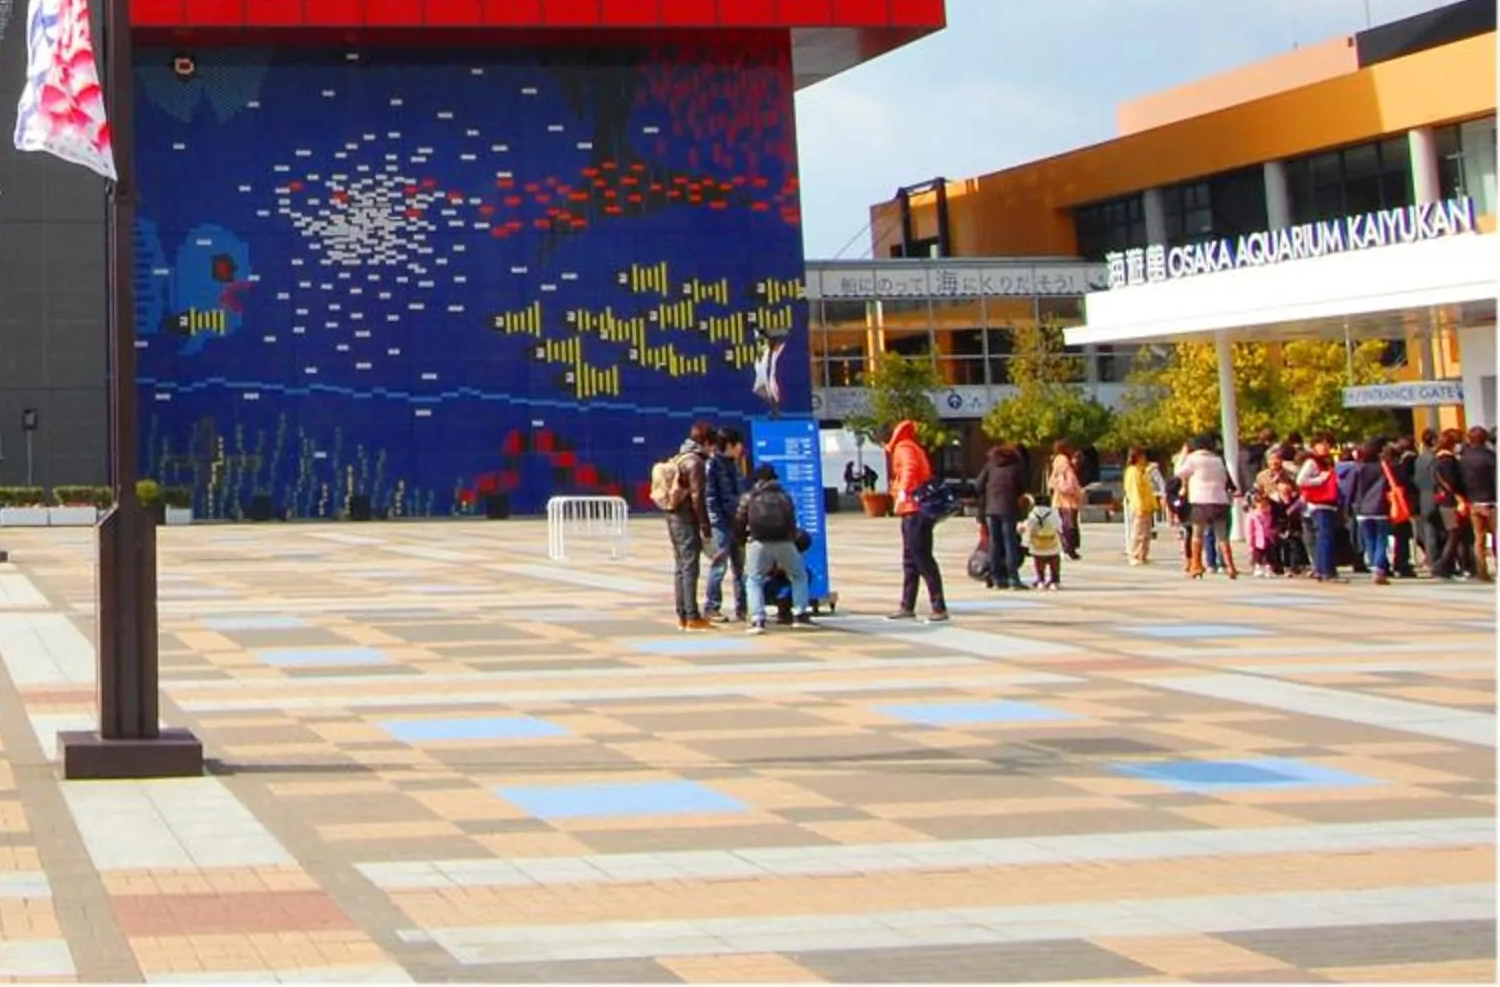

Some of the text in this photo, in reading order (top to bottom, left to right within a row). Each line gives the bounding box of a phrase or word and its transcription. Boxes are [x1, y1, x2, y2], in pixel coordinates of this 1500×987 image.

[1168, 238, 1231, 278] OSAKA
[1235, 219, 1343, 267] AQUARIUM
[1346, 197, 1474, 250] KAIYUKAN
